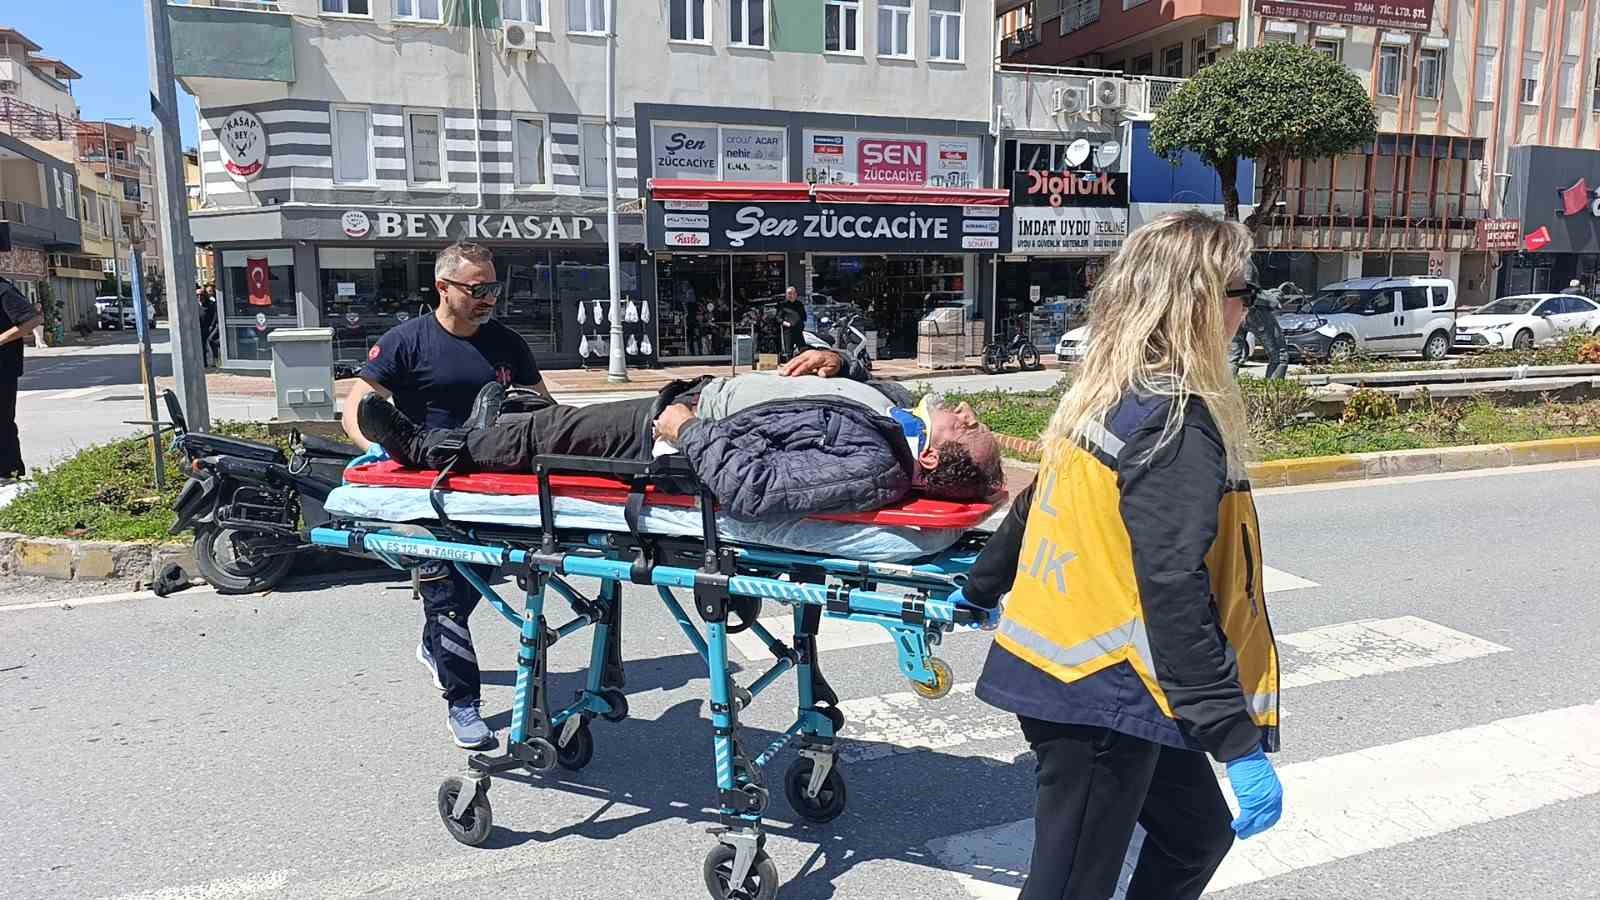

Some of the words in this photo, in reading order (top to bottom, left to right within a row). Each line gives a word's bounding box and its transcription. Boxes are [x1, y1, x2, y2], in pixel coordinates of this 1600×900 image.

[1395, 7, 1411, 17] LTD.
[227, 117, 256, 131] KASAP
[234, 131, 248, 140] BEY
[665, 132, 706, 155] Şen
[726, 148, 751, 159] nehir
[863, 143, 922, 166] ŞEN
[657, 156, 717, 168] ZÜCCACİYE
[863, 168, 923, 182] ZÜCCACİYE
[376, 212, 455, 238] BEY
[467, 214, 593, 240] KASAP
[725, 206, 799, 247] Şen
[803, 209, 949, 239] ZÜCCACİYE
[1018, 216, 1056, 236] İMDAT
[1060, 219, 1091, 236] UYDU
